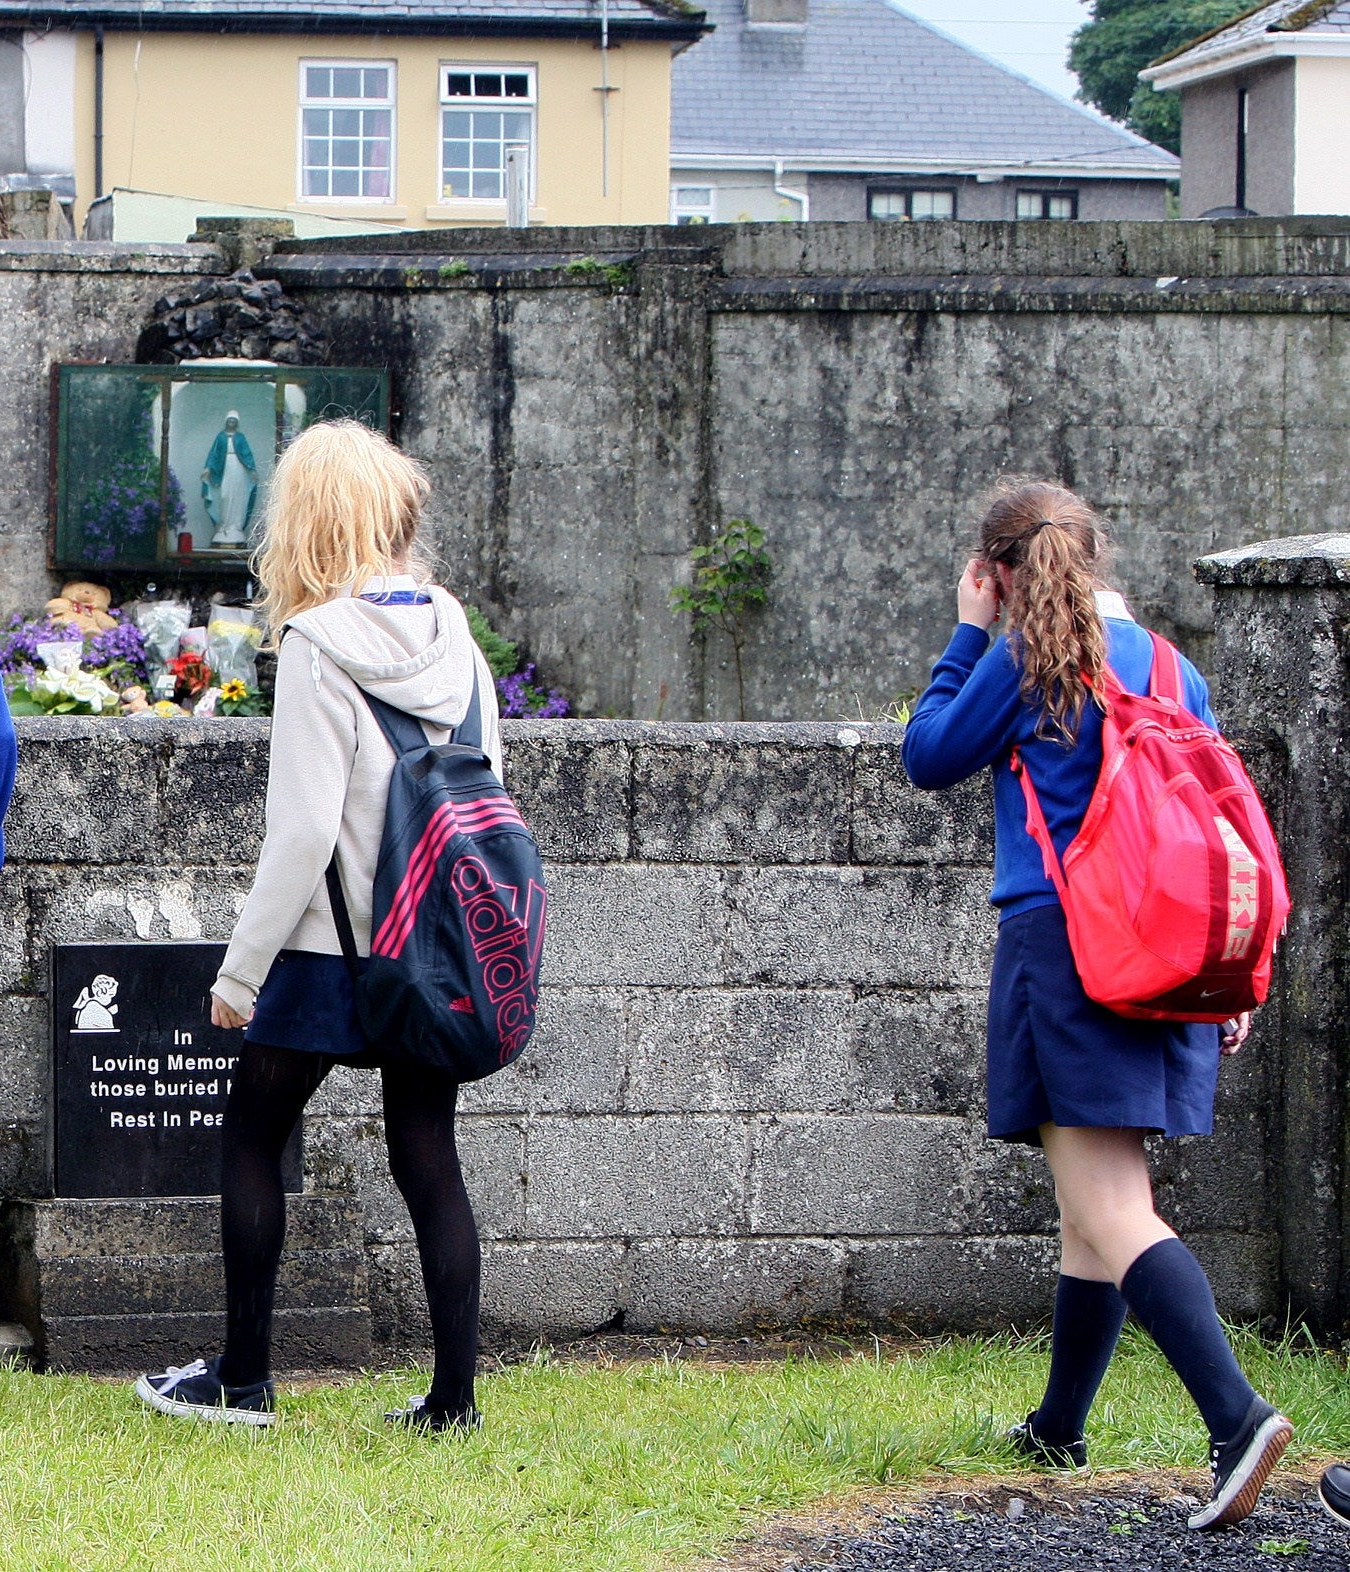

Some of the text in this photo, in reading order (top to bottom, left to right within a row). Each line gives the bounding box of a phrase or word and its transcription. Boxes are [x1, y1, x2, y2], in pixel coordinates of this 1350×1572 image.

[1213, 816, 1259, 961] NIKE
[174, 1029, 193, 1045] In
[92, 1055, 159, 1075] Loving
[90, 1081, 147, 1097] those
[154, 1079, 219, 1096] buried
[110, 1110, 224, 1128] Rest In Pea
